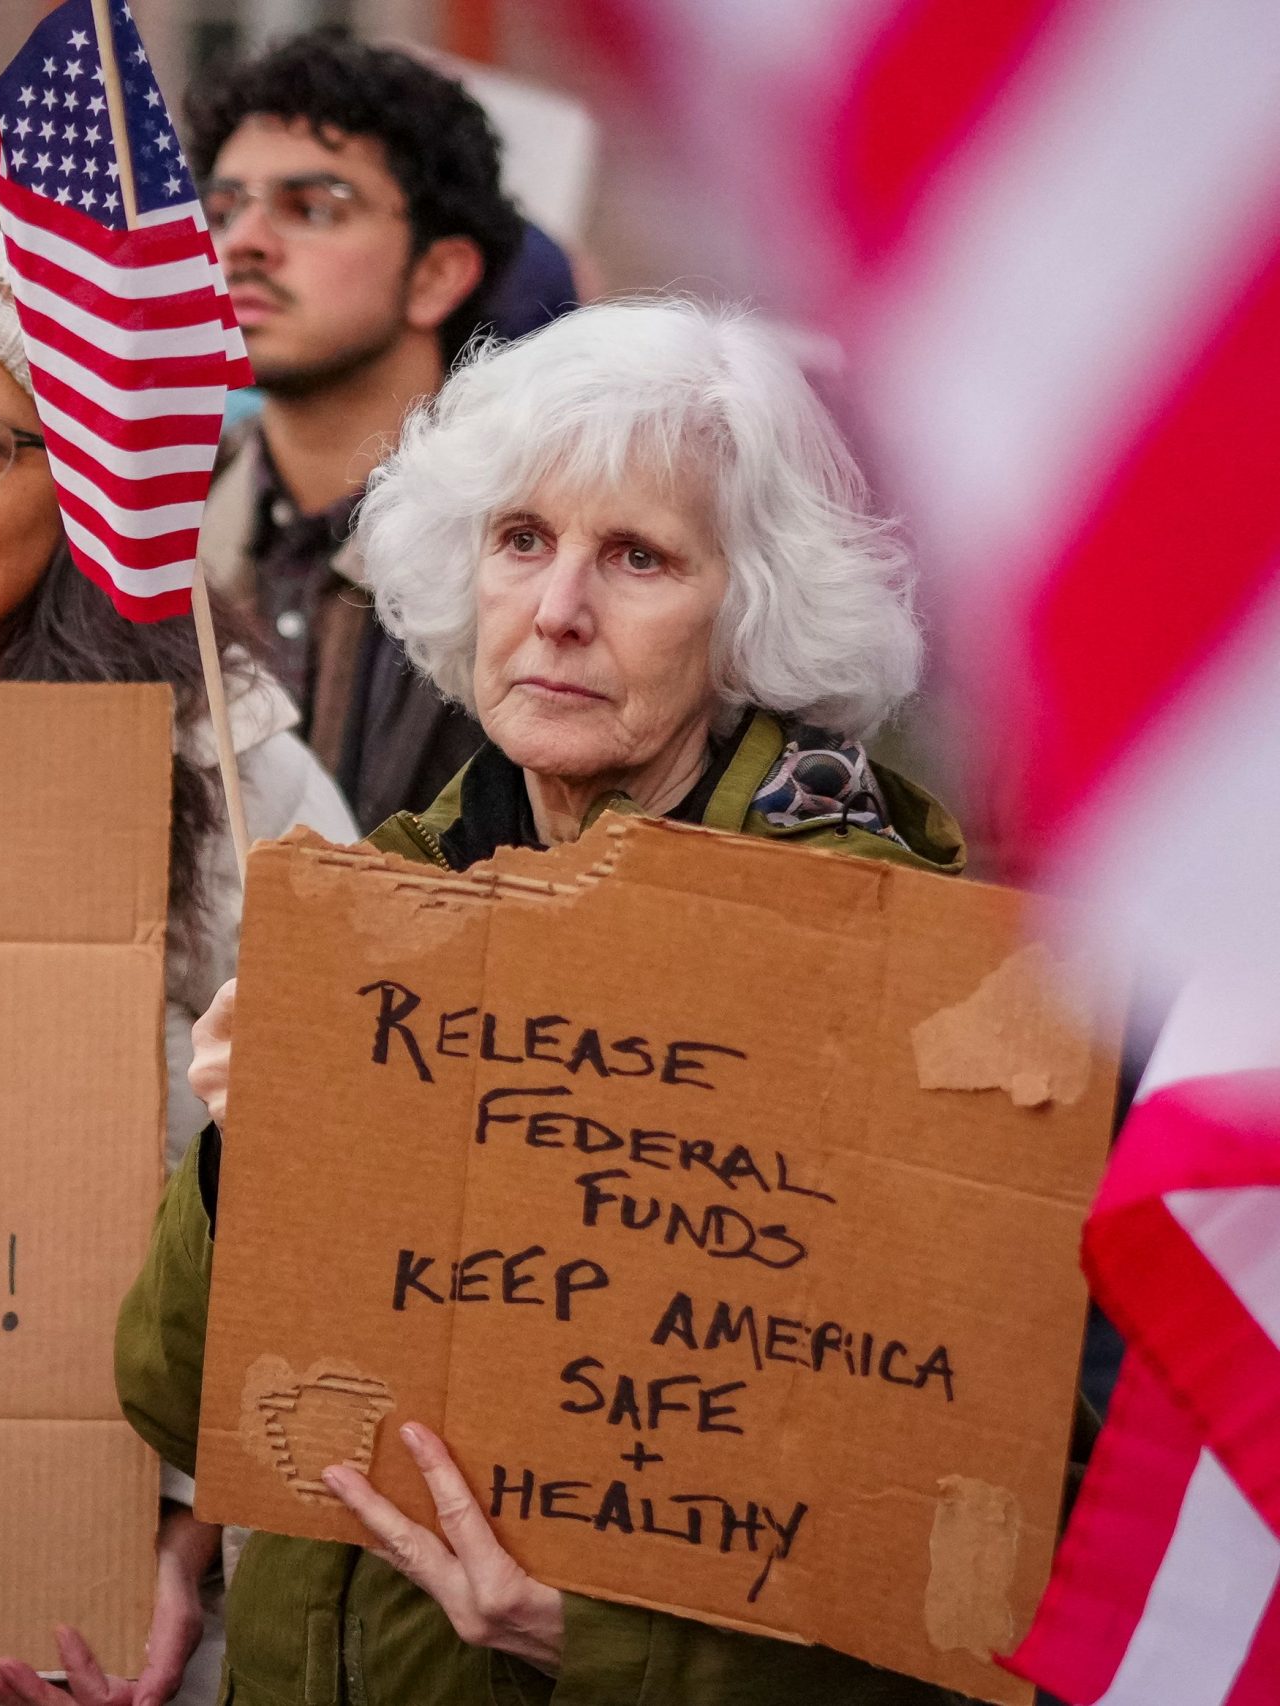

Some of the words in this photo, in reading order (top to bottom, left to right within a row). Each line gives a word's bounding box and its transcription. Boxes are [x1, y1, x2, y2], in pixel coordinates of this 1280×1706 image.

[357, 979, 747, 1090] RELEASE
[475, 1086, 836, 1204] FEDERAL
[575, 1169, 807, 1268] FUNDS
[392, 1245, 609, 1321] KEEP
[651, 1292, 955, 1401] AMERICA
[559, 1356, 747, 1434] SAFE
[489, 1464, 808, 1603] HEALTHY
